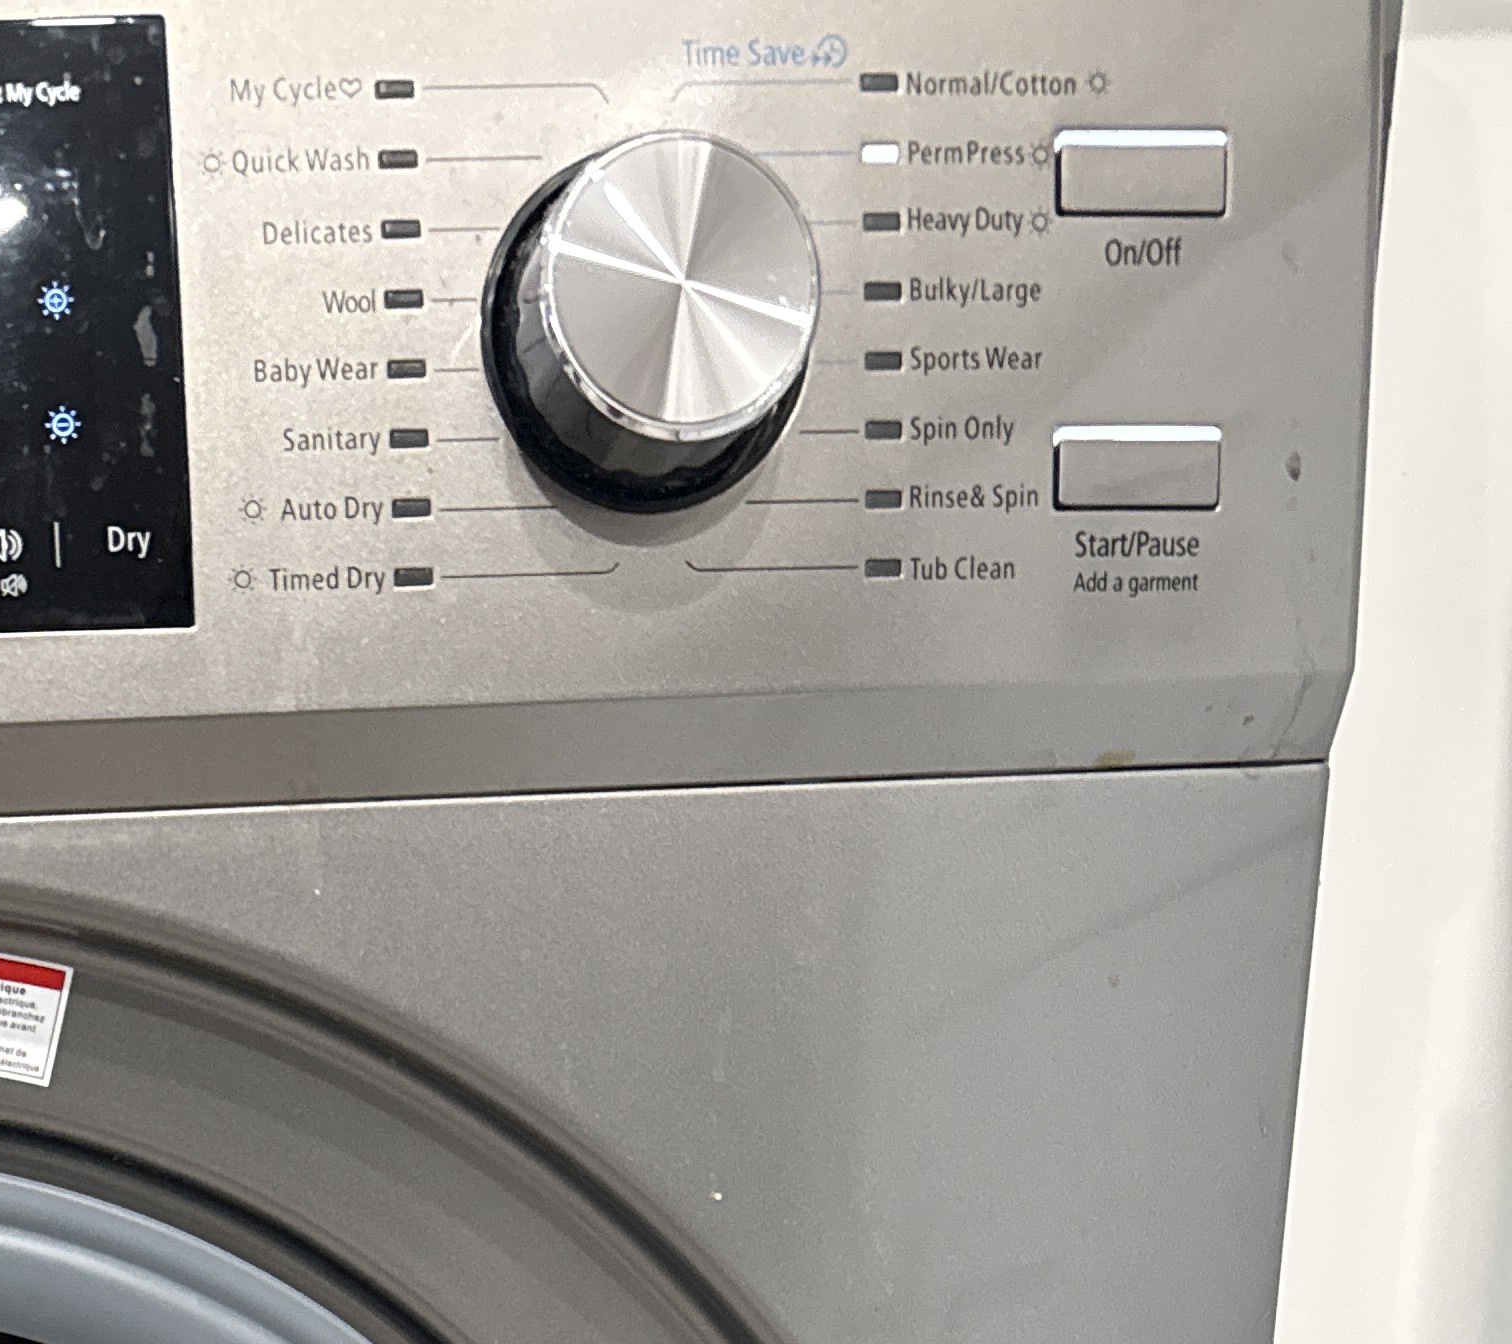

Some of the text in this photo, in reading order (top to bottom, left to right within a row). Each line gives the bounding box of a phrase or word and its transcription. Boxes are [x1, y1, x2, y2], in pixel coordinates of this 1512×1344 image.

[682, 38, 806, 67] Time Save
[5, 83, 34, 107] My
[36, 82, 81, 107] Cycle
[231, 76, 336, 103] My Cycle
[907, 71, 1077, 96] Normal/Cotton
[232, 147, 369, 176] Quick Wash
[263, 220, 372, 245] Delicates
[908, 206, 1023, 238] Heavy Duty
[1105, 236, 1182, 266] On/Off
[322, 289, 376, 313] Wool
[910, 277, 1041, 308] Bulky/Large
[254, 357, 378, 388] Baby Wear
[911, 346, 1042, 376] Sports Wear
[283, 427, 380, 456] Sanitary
[911, 415, 1014, 446] Spin Only
[281, 496, 383, 525] Auto Dry
[993, 484, 1038, 513] Spin
[108, 526, 150, 558] Dry
[1076, 530, 1199, 558] Start/Pause
[269, 566, 385, 594] Timed Dry
[910, 556, 1014, 580] Tub Clean
[1074, 571, 1198, 597] Add a garment
